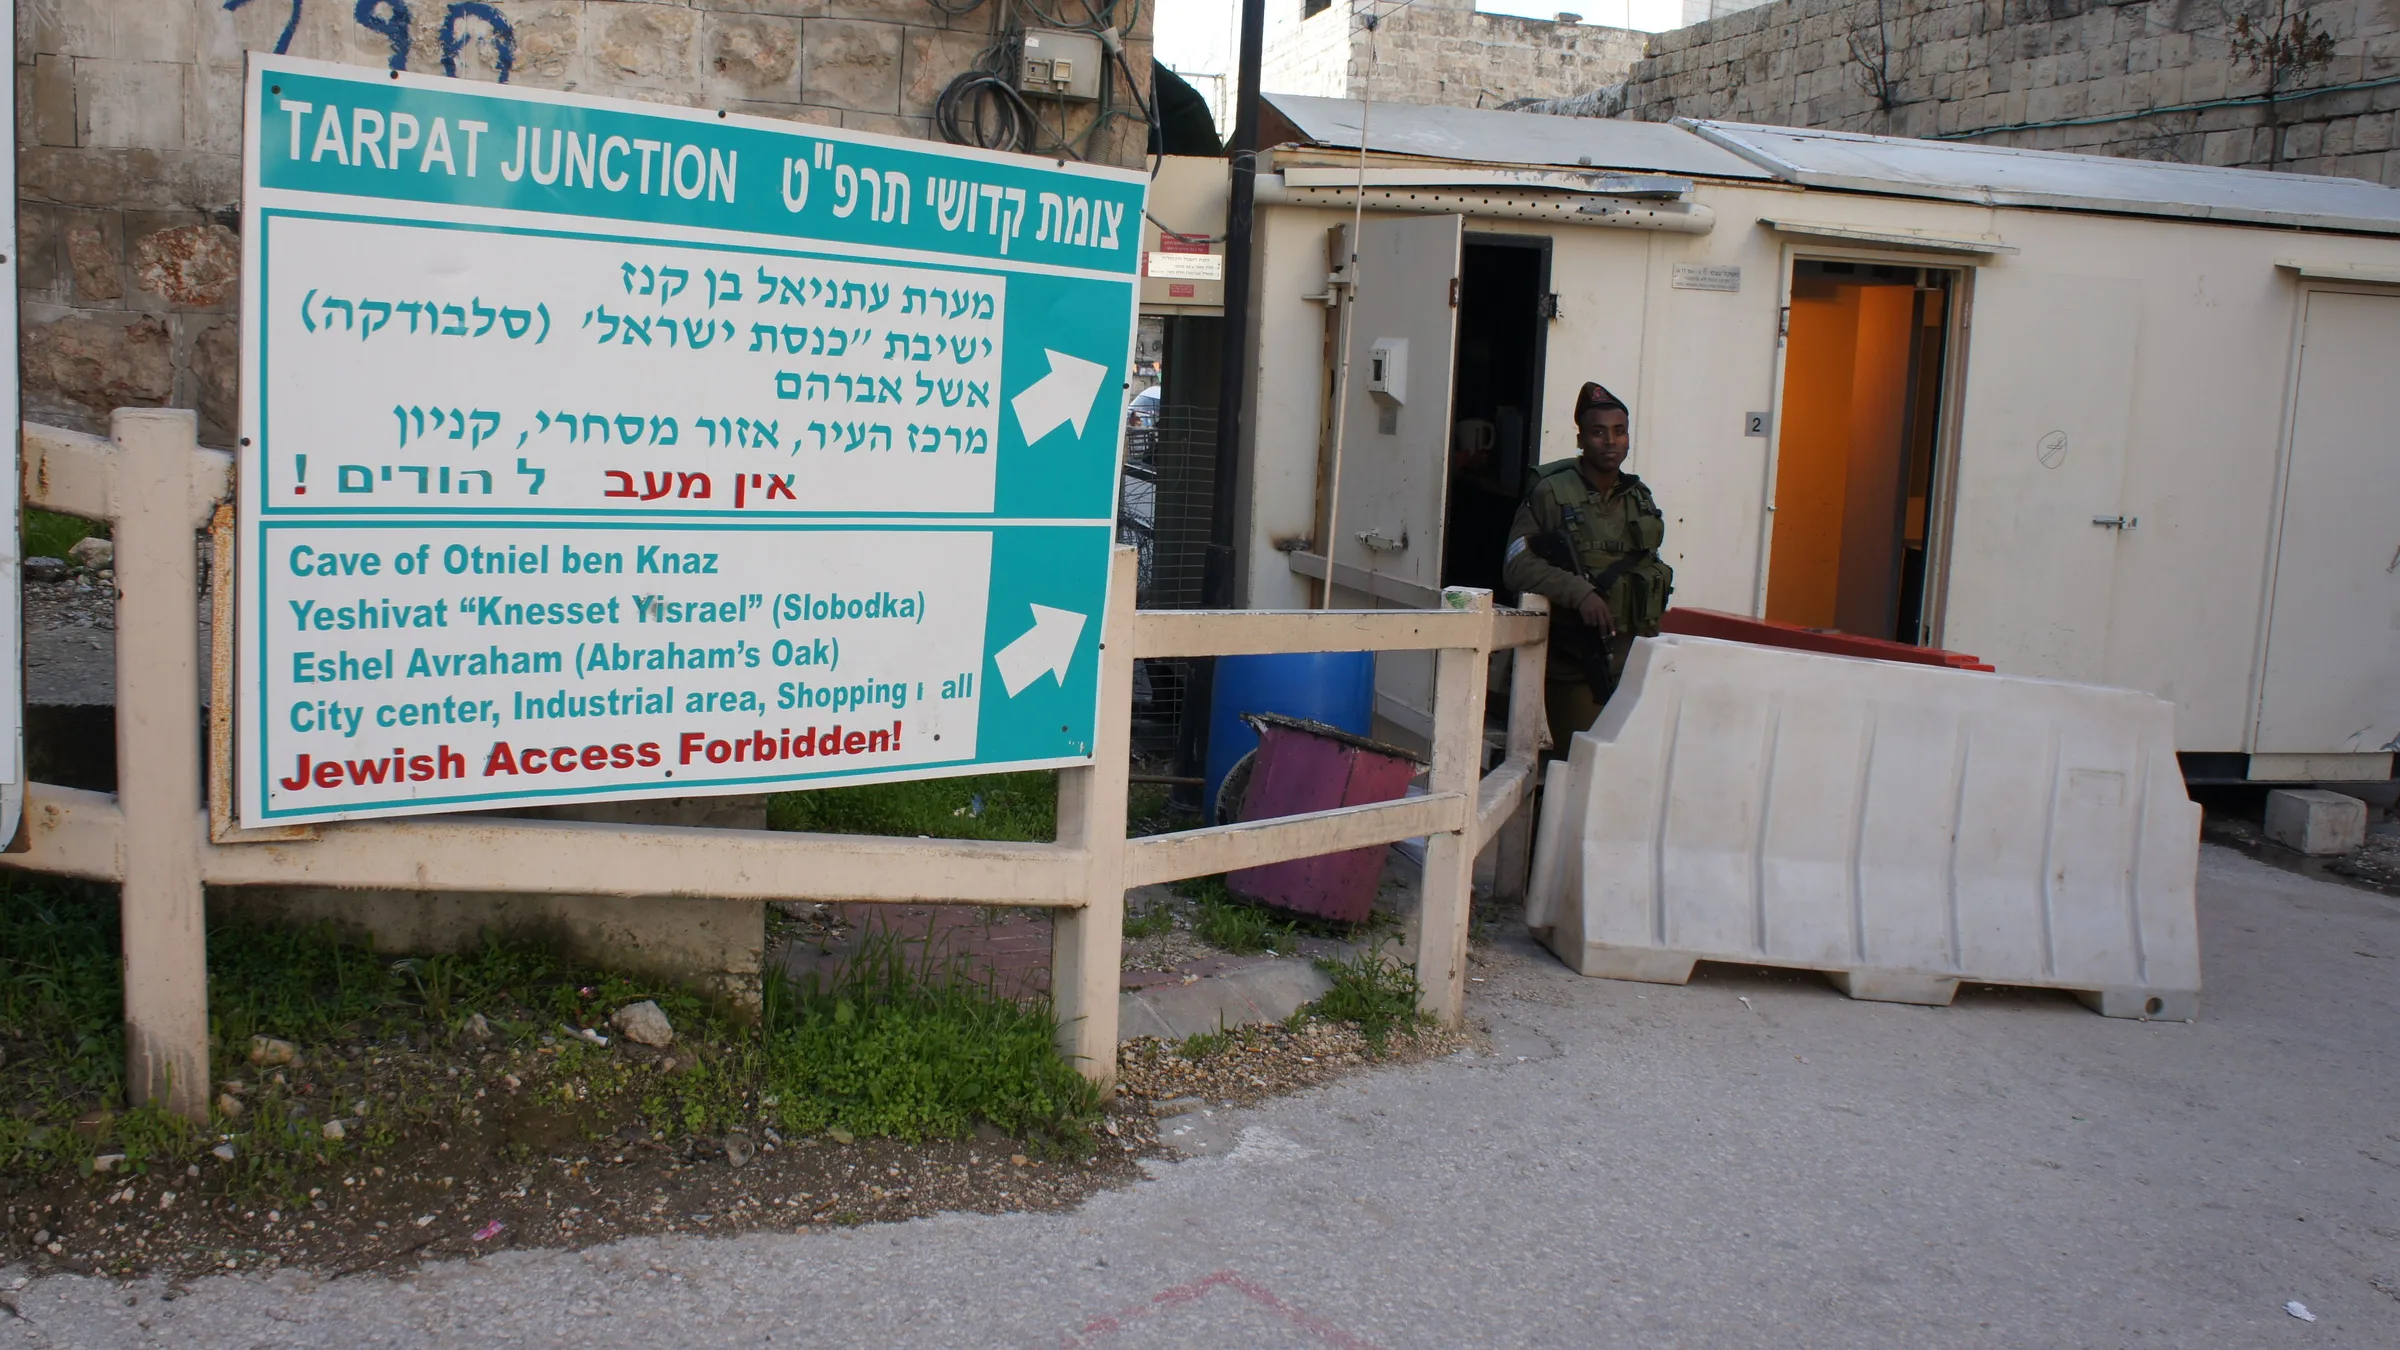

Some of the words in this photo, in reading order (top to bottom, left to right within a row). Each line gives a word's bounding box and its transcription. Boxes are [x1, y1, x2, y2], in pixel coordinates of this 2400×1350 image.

[280, 100, 488, 176] TARPAT
[501, 126, 736, 202] JUNCTION
[783, 143, 910, 224] תרפ"ט
[927, 177, 1025, 254] קדושי
[1037, 193, 1123, 249] צומת
[621, 262, 688, 304] קנז
[705, 269, 742, 307] בן
[758, 266, 889, 312] עתניאל
[302, 289, 550, 343] (סלבודקה)
[901, 286, 994, 319] מערת
[884, 331, 992, 364] ישיבת
[775, 370, 902, 403] אברהם
[916, 371, 989, 407] אשל
[394, 405, 500, 448] קניון
[518, 410, 678, 447] מסחרי,
[696, 417, 779, 448] אזור
[793, 422, 892, 455] העיר,
[907, 424, 988, 454] מרכז
[1752, 417, 1761, 432] 2
[606, 471, 711, 501] מעב
[736, 474, 796, 508] אין
[290, 545, 380, 576] Cave
[395, 544, 430, 574] of
[444, 544, 548, 574] Otniel
[562, 545, 622, 574] ben
[637, 546, 718, 574] Knaz
[289, 598, 447, 631] Yeshivat
[460, 596, 619, 625] “Knesset
[632, 594, 762, 623] Yisrael”
[773, 591, 924, 628] (Slobodka)
[293, 649, 392, 683] Eshel
[407, 646, 561, 678] Avraham
[576, 640, 760, 679] (Abraham’s
[772, 638, 838, 671] Oak)
[290, 701, 363, 737] City
[376, 696, 499, 728] center,
[515, 687, 673, 720] Industrial
[686, 691, 765, 716] area,
[778, 678, 906, 712] Shopping
[282, 745, 465, 791] Jewish
[485, 742, 661, 776] Access
[681, 721, 902, 765] Forbidden!
